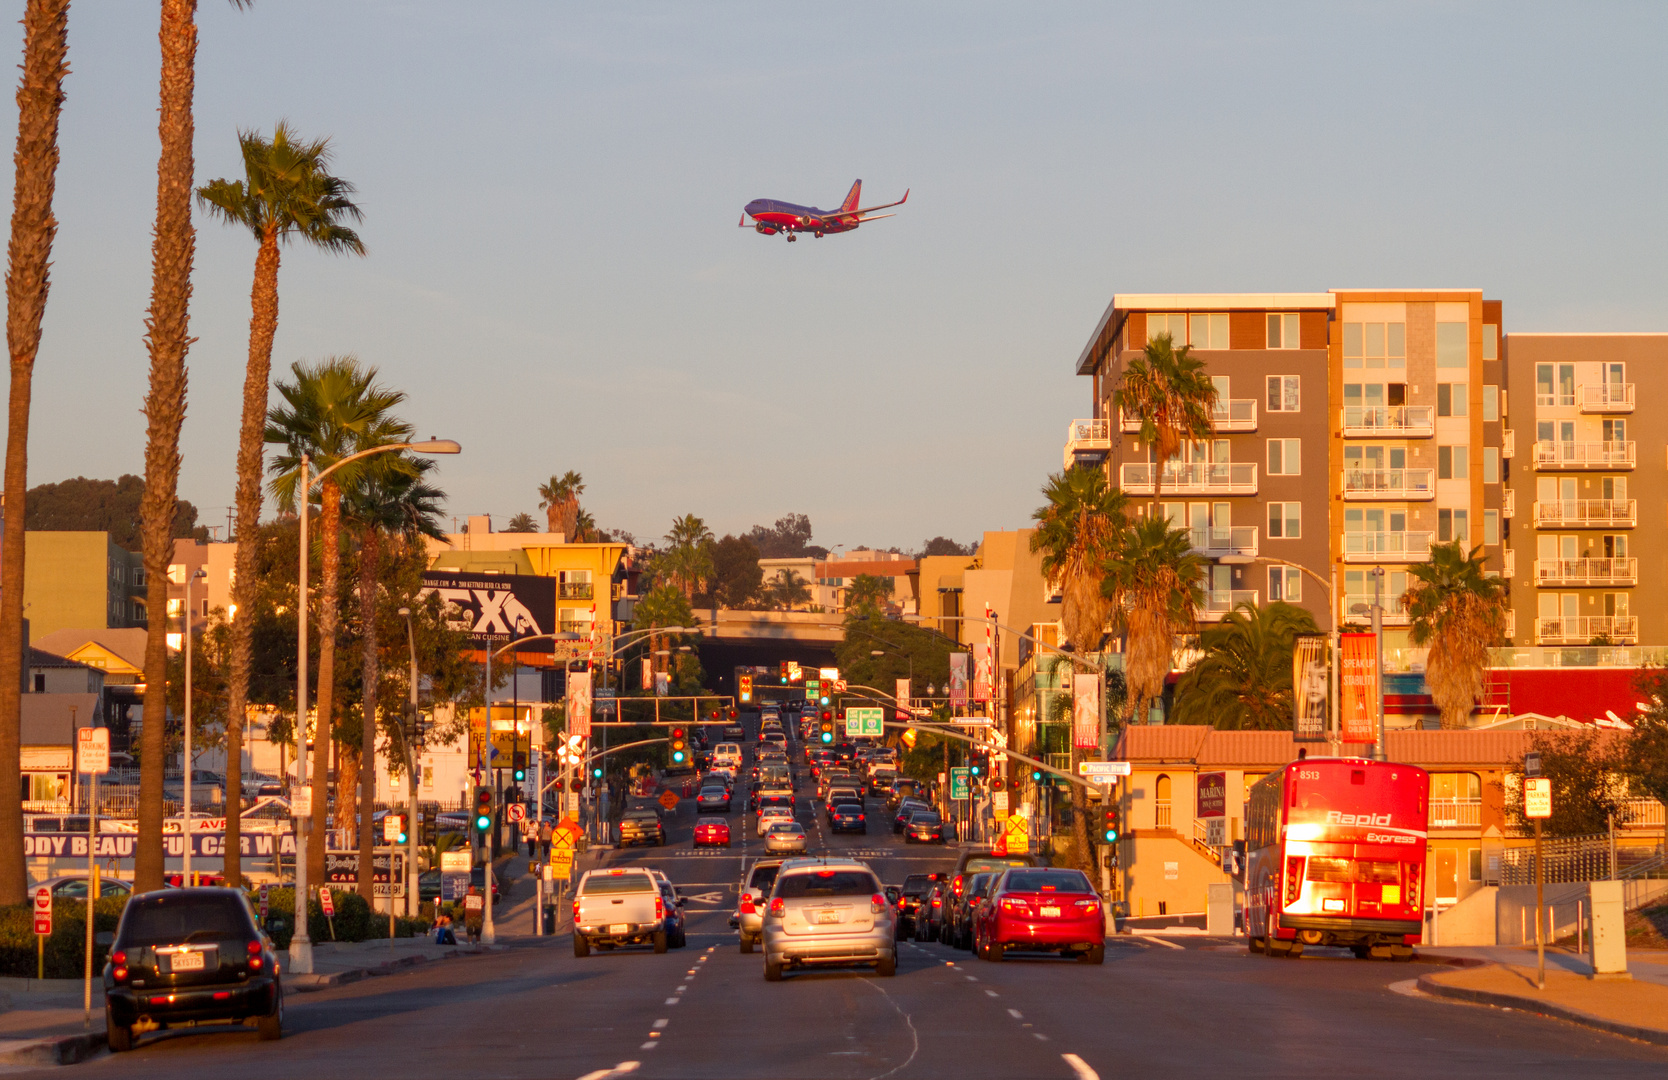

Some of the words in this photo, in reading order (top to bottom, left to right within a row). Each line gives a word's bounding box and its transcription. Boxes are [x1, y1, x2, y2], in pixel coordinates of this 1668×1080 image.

[1344, 659, 1364, 668] SPEAK
[1367, 659, 1375, 668] UP
[1343, 675, 1375, 686] STABILITY
[1076, 725, 1097, 734] LITTLE
[81, 730, 92, 740] NO
[81, 742, 106, 750] PARKING
[1076, 736, 1097, 746] ITALY
[1300, 771, 1320, 780] 8513
[1200, 786, 1224, 799] MARINA
[1326, 810, 1392, 827] Rapid
[1366, 832, 1416, 844] Express
[331, 873, 355, 881] CAR
